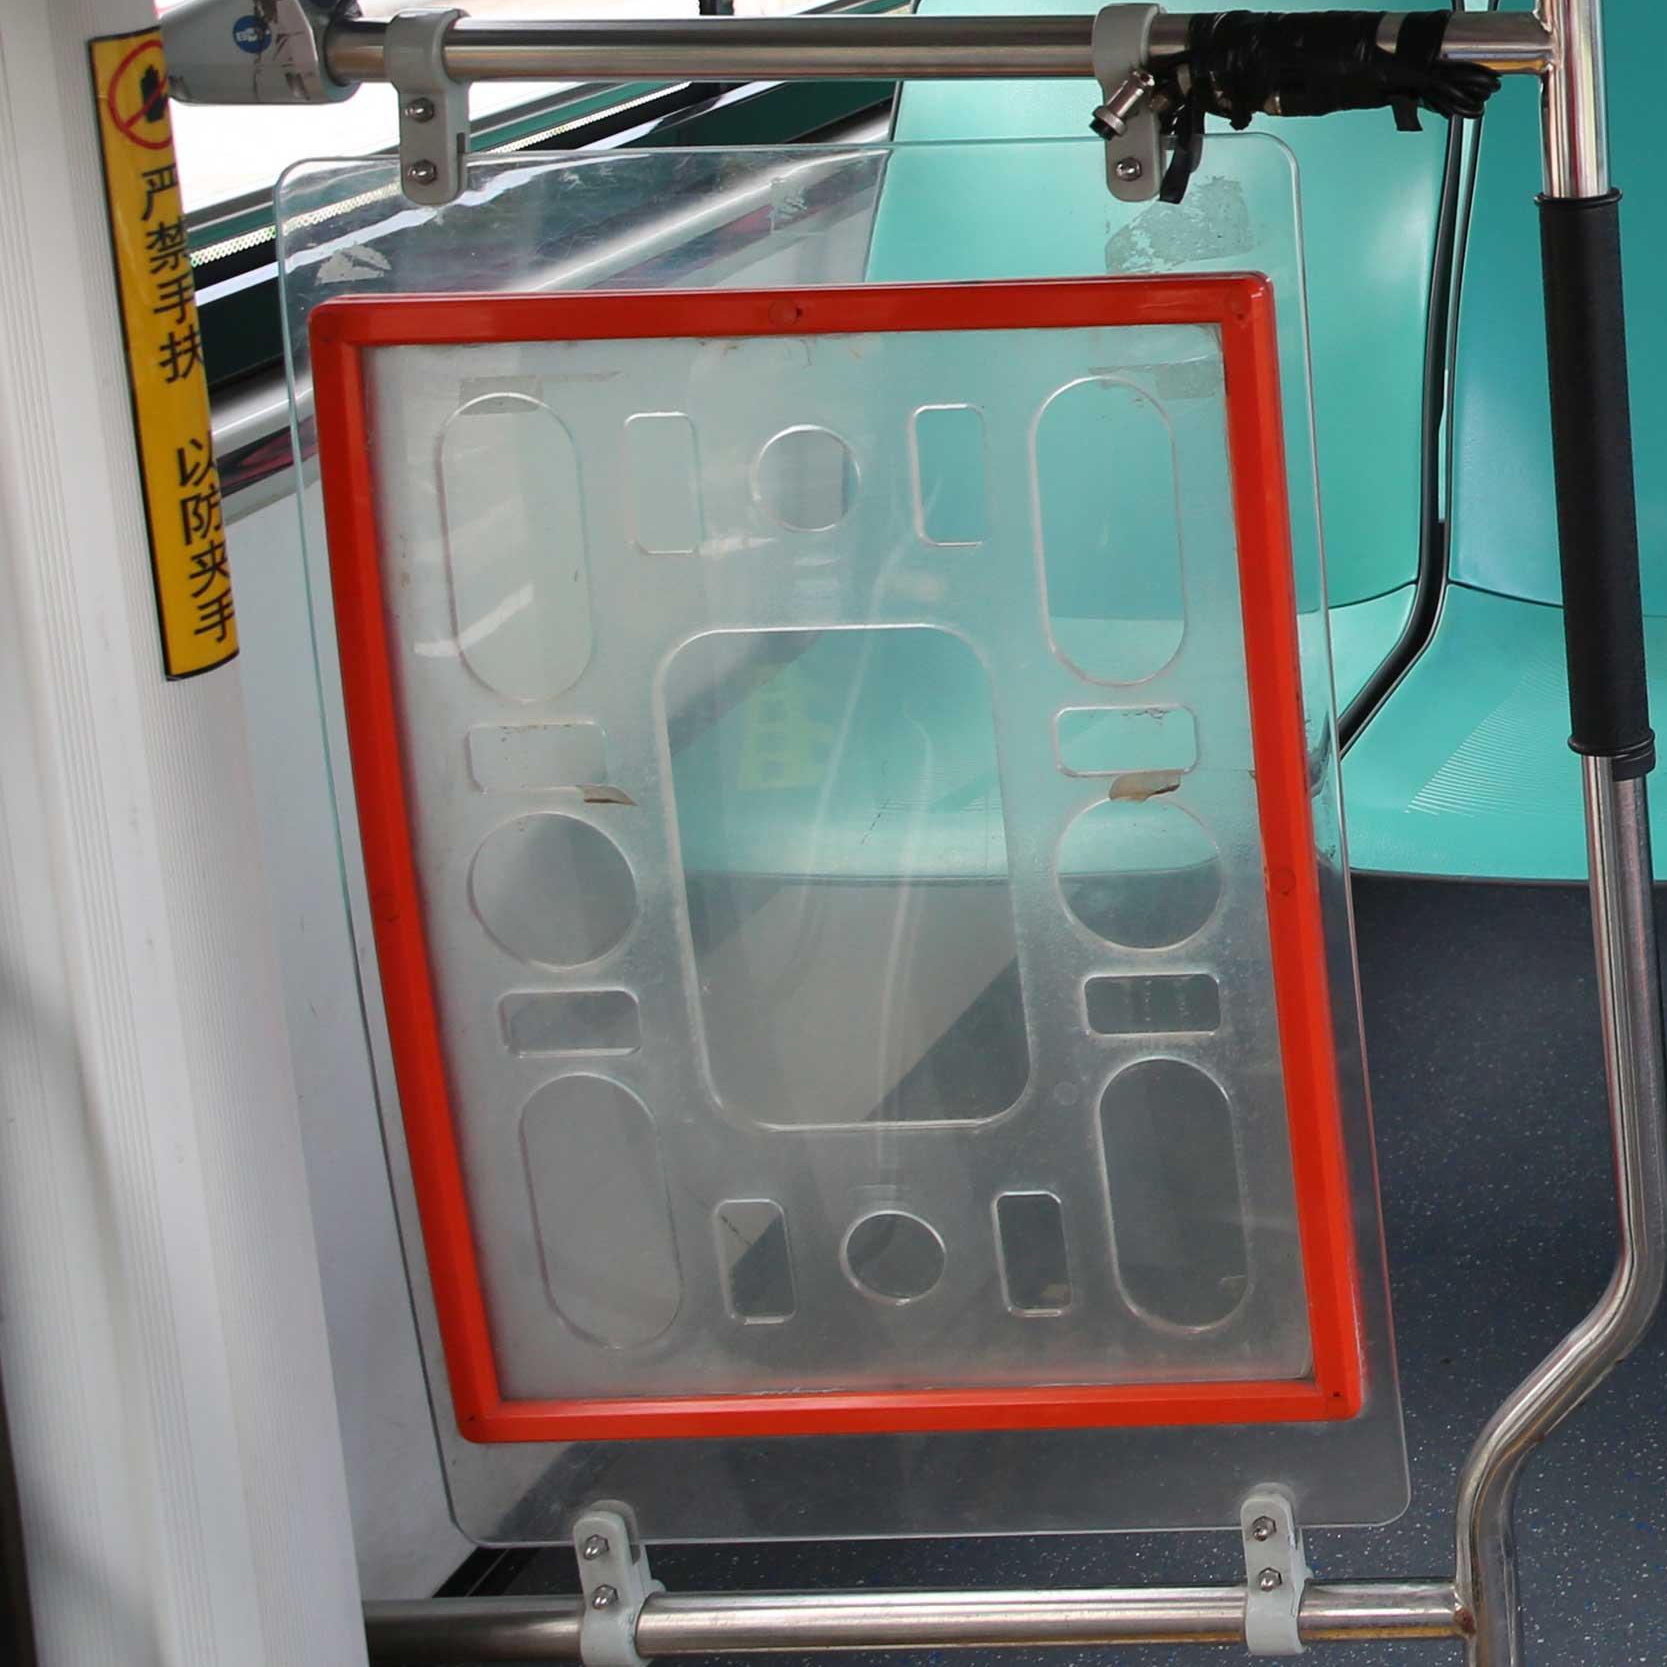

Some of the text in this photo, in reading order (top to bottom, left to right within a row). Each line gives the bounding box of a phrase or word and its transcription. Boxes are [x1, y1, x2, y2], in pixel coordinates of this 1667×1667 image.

[140, 165, 236, 643] 严禁手扶 以防夹手
